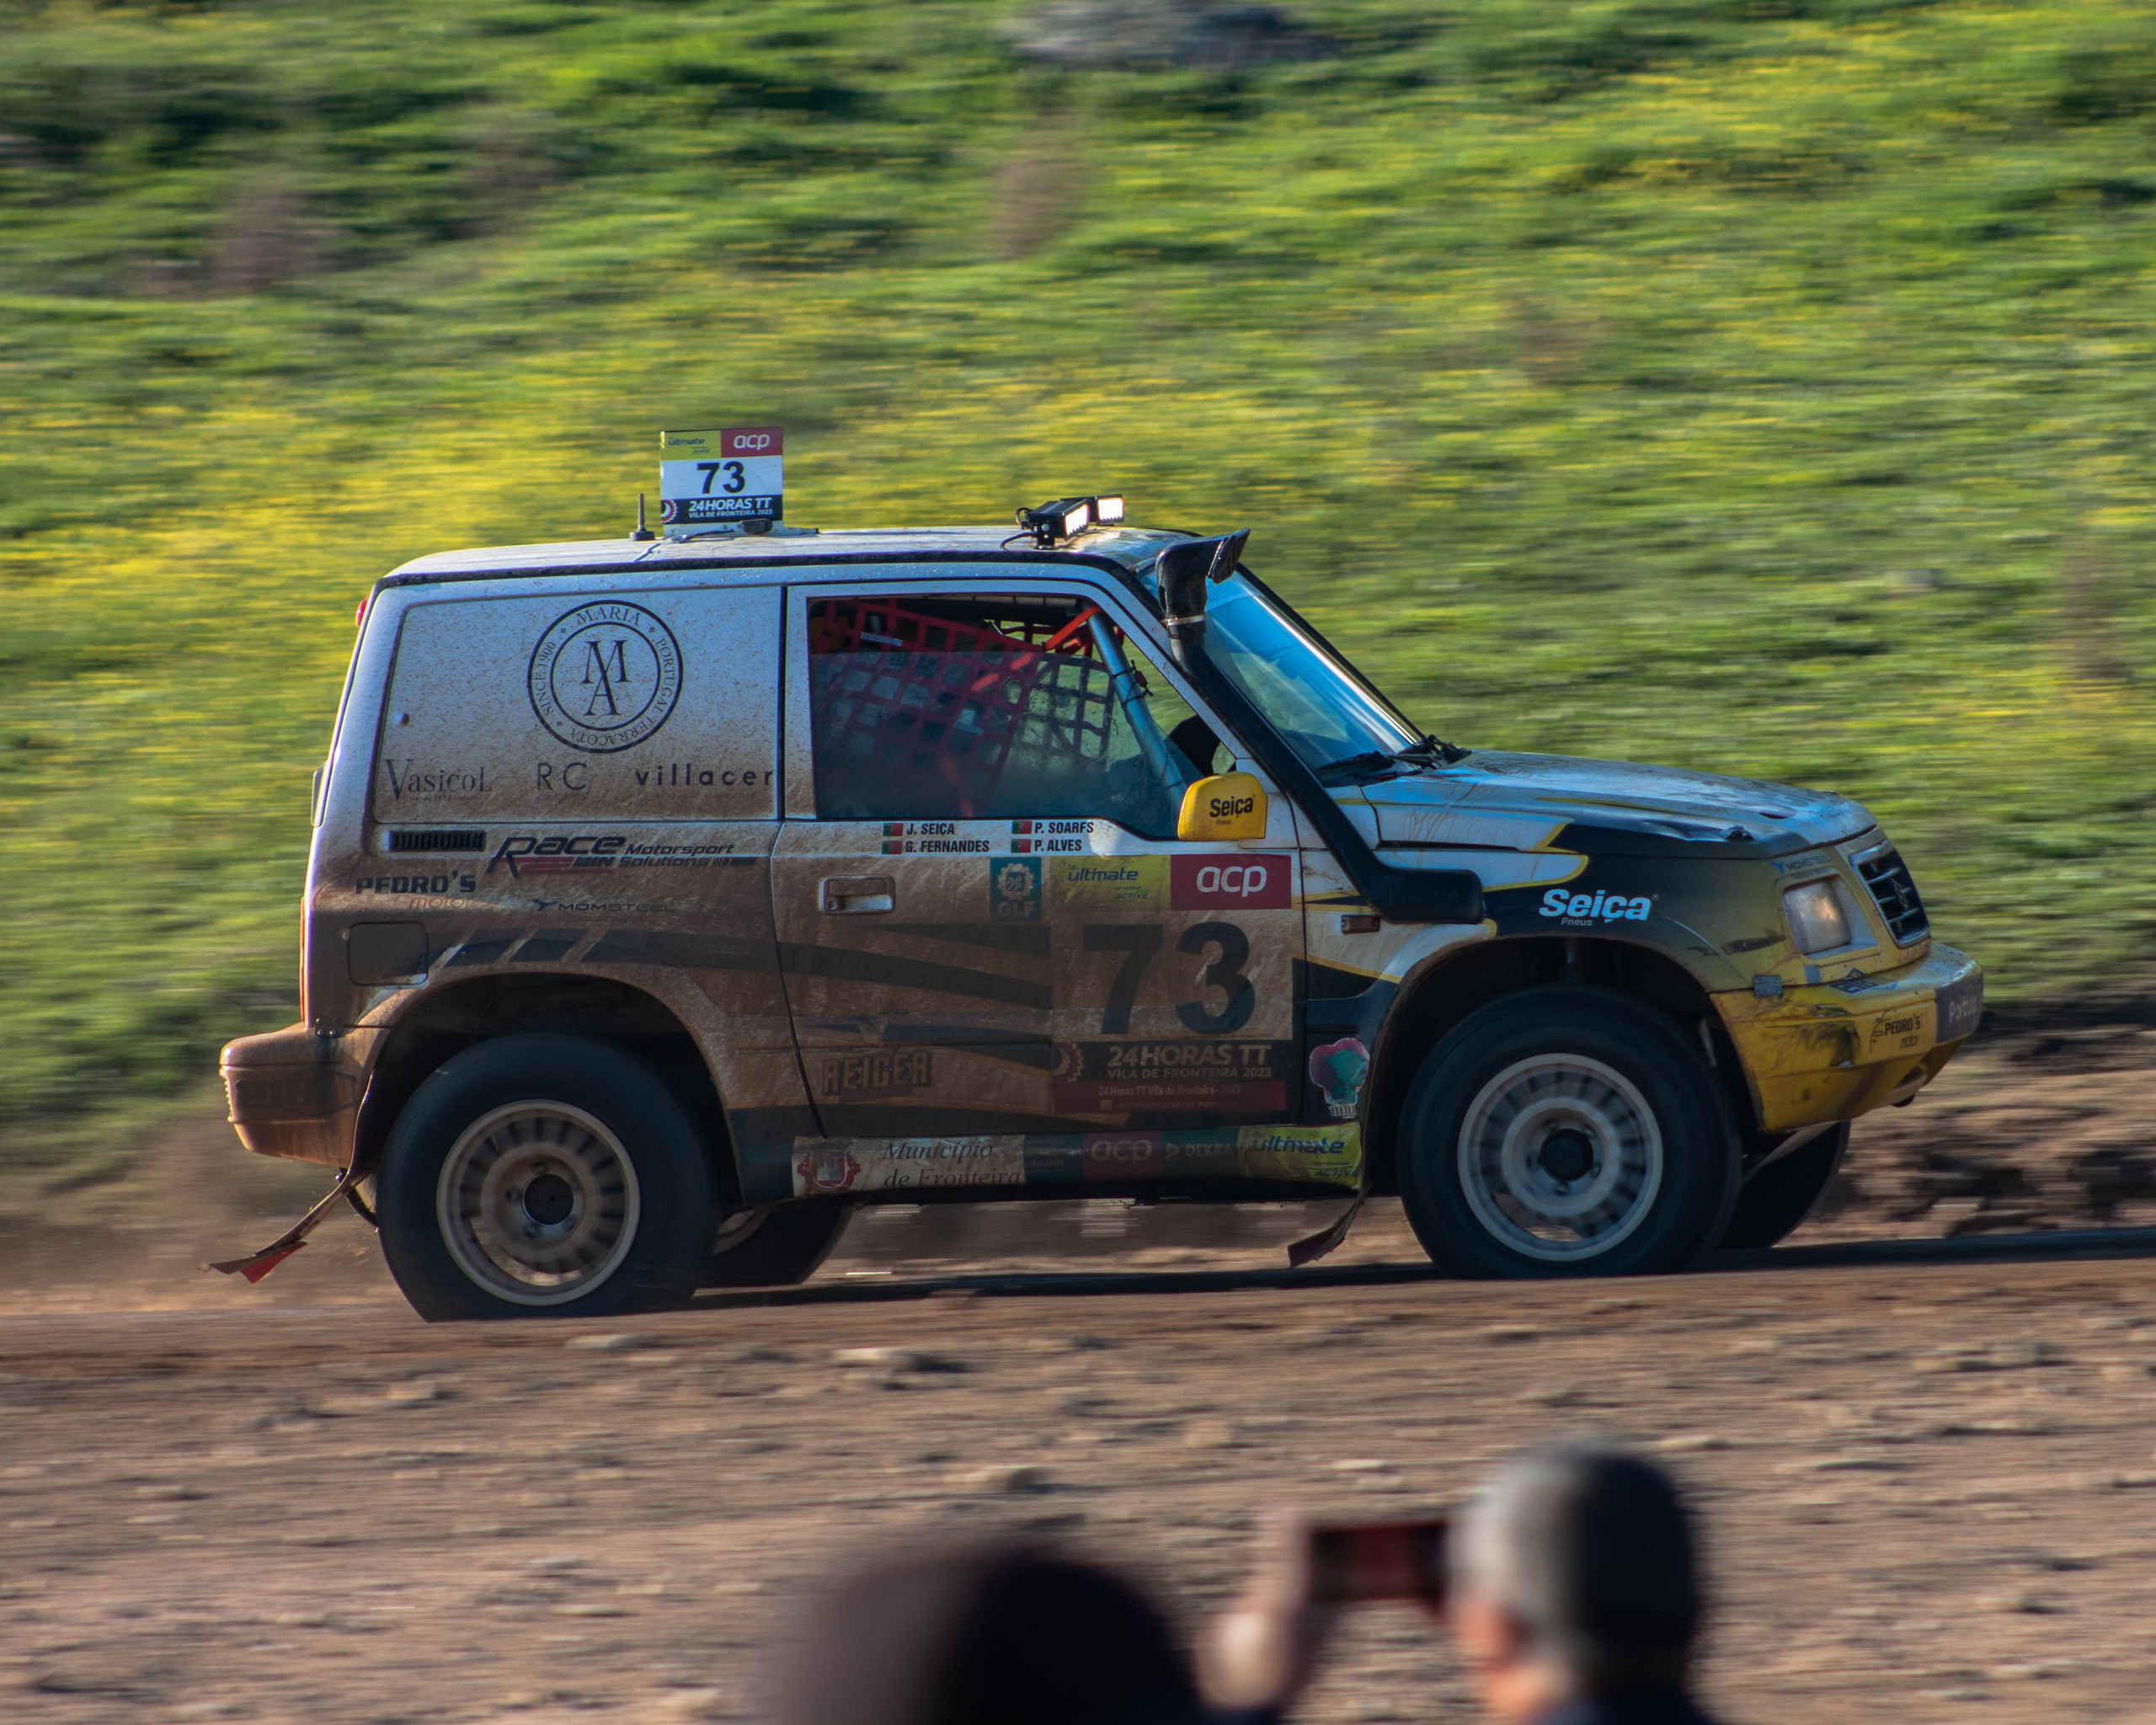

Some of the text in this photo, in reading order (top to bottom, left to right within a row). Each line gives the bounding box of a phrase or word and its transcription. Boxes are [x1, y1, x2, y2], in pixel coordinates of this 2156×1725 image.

[668, 437, 705, 446] ultimate
[734, 434, 770, 451] acp
[696, 461, 745, 494] 73
[755, 497, 772, 509] TT
[577, 606, 641, 626] MARIA
[569, 638, 675, 746] PORTUGAL TERRACOTA
[635, 762, 773, 786] villacer
[1209, 796, 1253, 818] Seiça
[906, 823, 955, 836] J. SEIÇA
[1034, 822, 1044, 834] P.
[624, 843, 735, 857] Motorsport
[905, 841, 990, 852] G. FERNANDES
[1034, 839, 1082, 852] P. ALVES
[619, 857, 713, 868] Solutions
[1068, 868, 1139, 882] ultimate
[1196, 866, 1267, 898] acp
[558, 904, 675, 912] MOMSTEEL
[1539, 889, 1652, 923] Seiça
[1561, 917, 1593, 926] Pneus
[1083, 921, 1256, 1035] 73
[1885, 1013, 1921, 1036] PEDRO'S
[1238, 1044, 1272, 1065] TT
[1107, 1066, 1272, 1080] VILA DE FRONTEIRA 2023
[1099, 1087, 1108, 1096] 24
[1110, 1086, 1134, 1096] Horas
[1136, 1086, 1146, 1095] TT
[1147, 1085, 1164, 1096] Vila
[1165, 1085, 1176, 1095] de
[1177, 1084, 1214, 1095] Fronteira
[883, 1141, 994, 1164] Município
[1091, 1139, 1152, 1166] acp
[1251, 1135, 1345, 1154] ultimate
[884, 1169, 1021, 1188] de Fronteira
